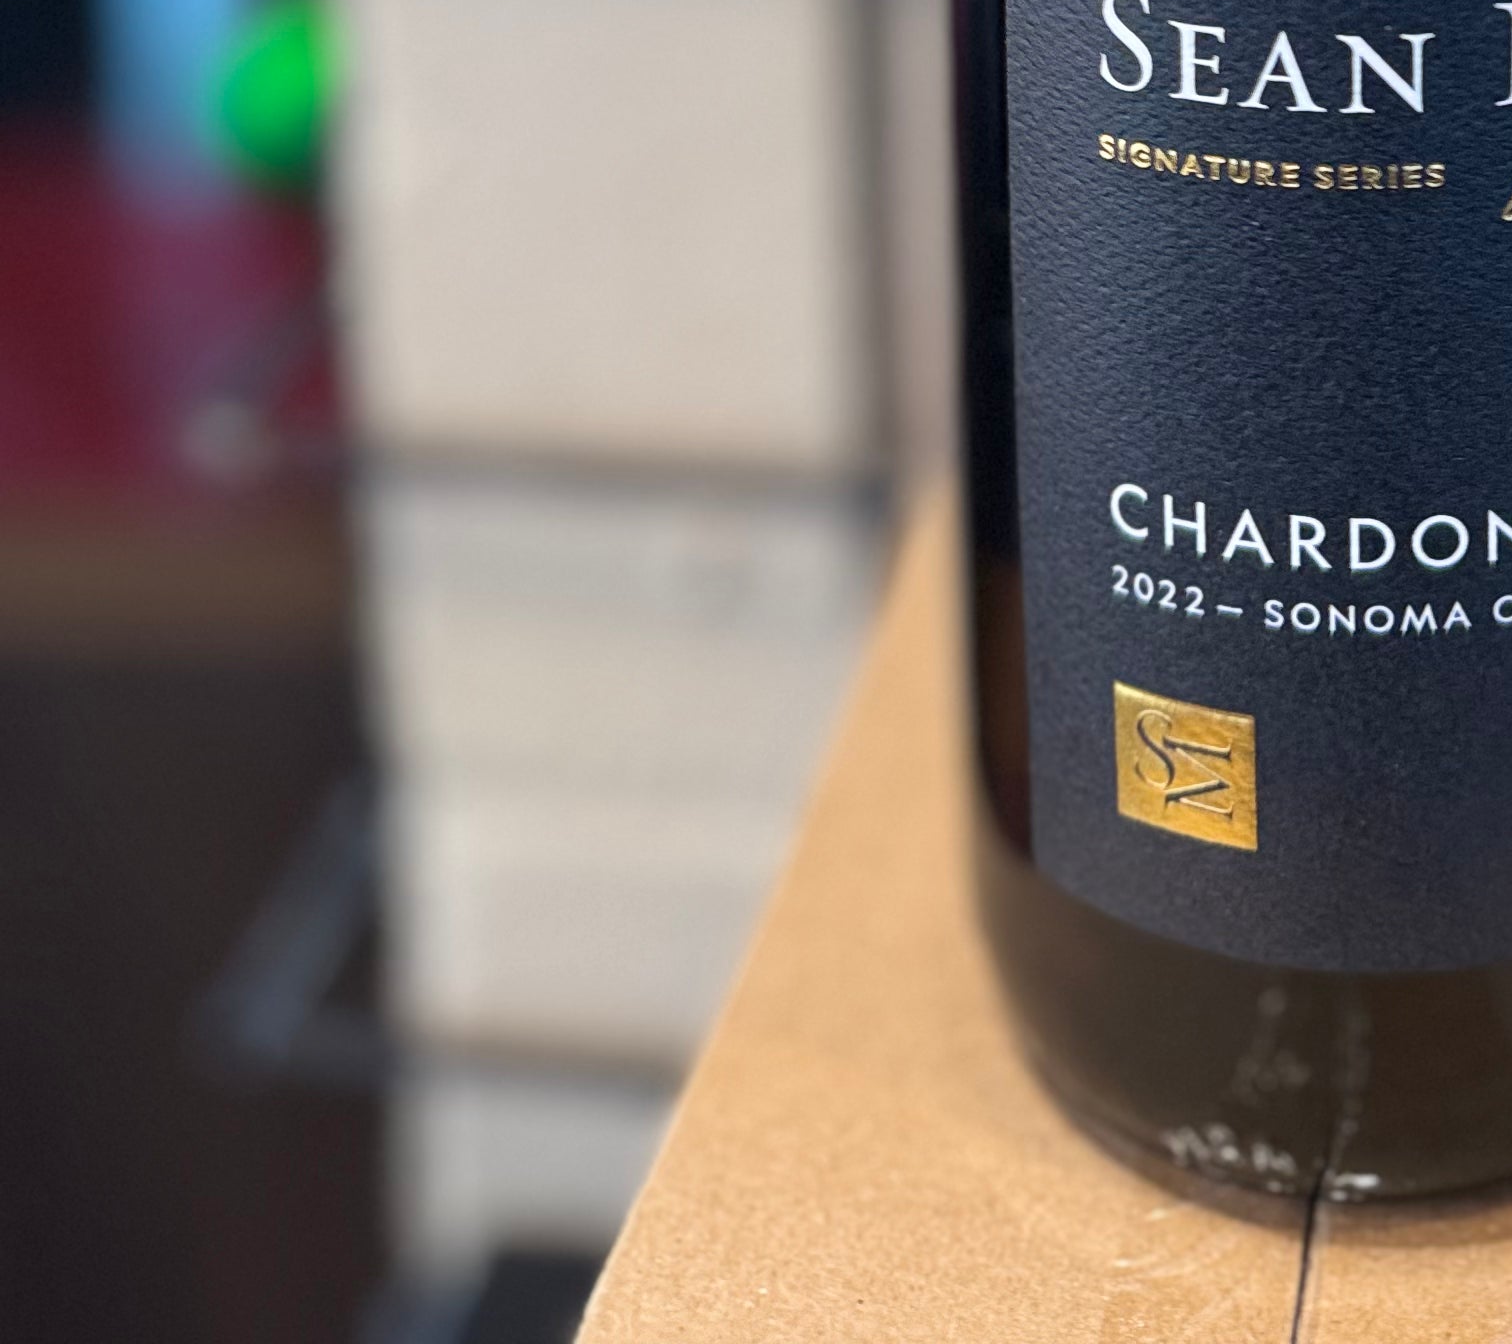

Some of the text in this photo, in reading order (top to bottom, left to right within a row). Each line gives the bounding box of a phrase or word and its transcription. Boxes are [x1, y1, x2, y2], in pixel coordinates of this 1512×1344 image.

[1097, 133, 1447, 191] SIGNATURE SERIES
[1263, 599, 1472, 637] SONOMA
